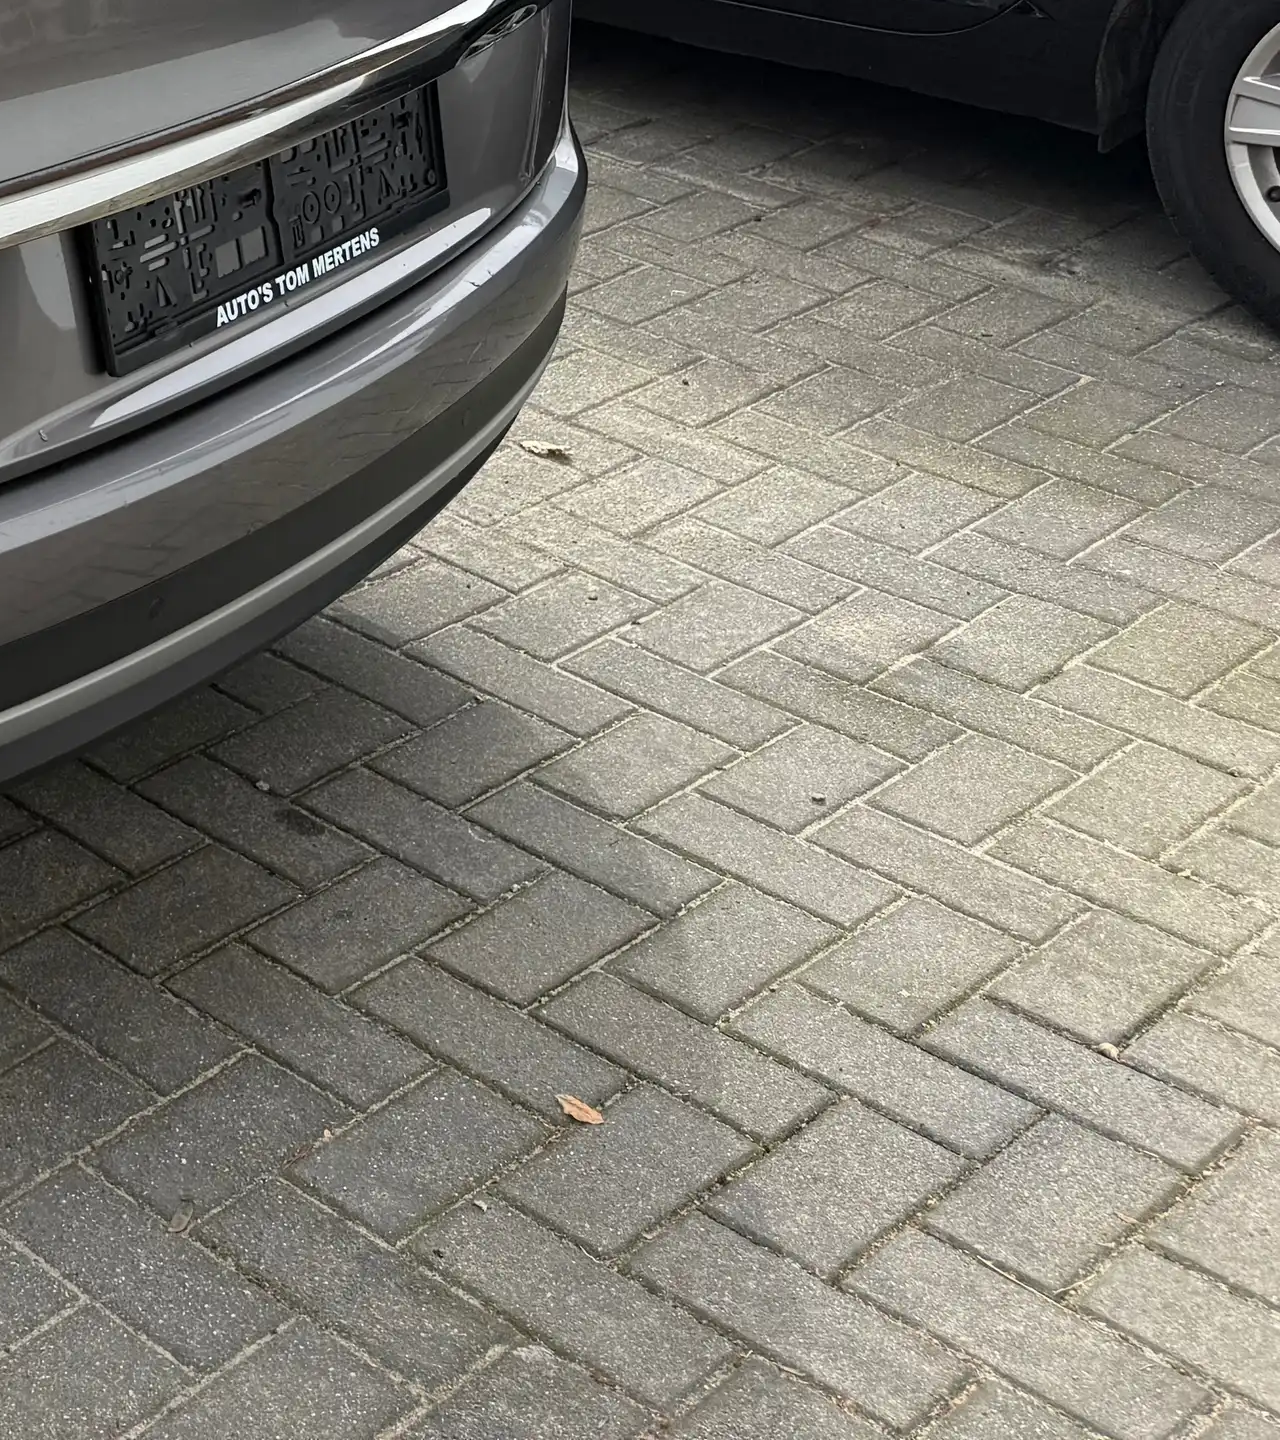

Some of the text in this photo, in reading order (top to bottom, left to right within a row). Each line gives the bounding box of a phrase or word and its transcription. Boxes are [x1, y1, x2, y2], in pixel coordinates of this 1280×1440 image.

[216, 227, 381, 328] AUTO'S TOM MERTENS
